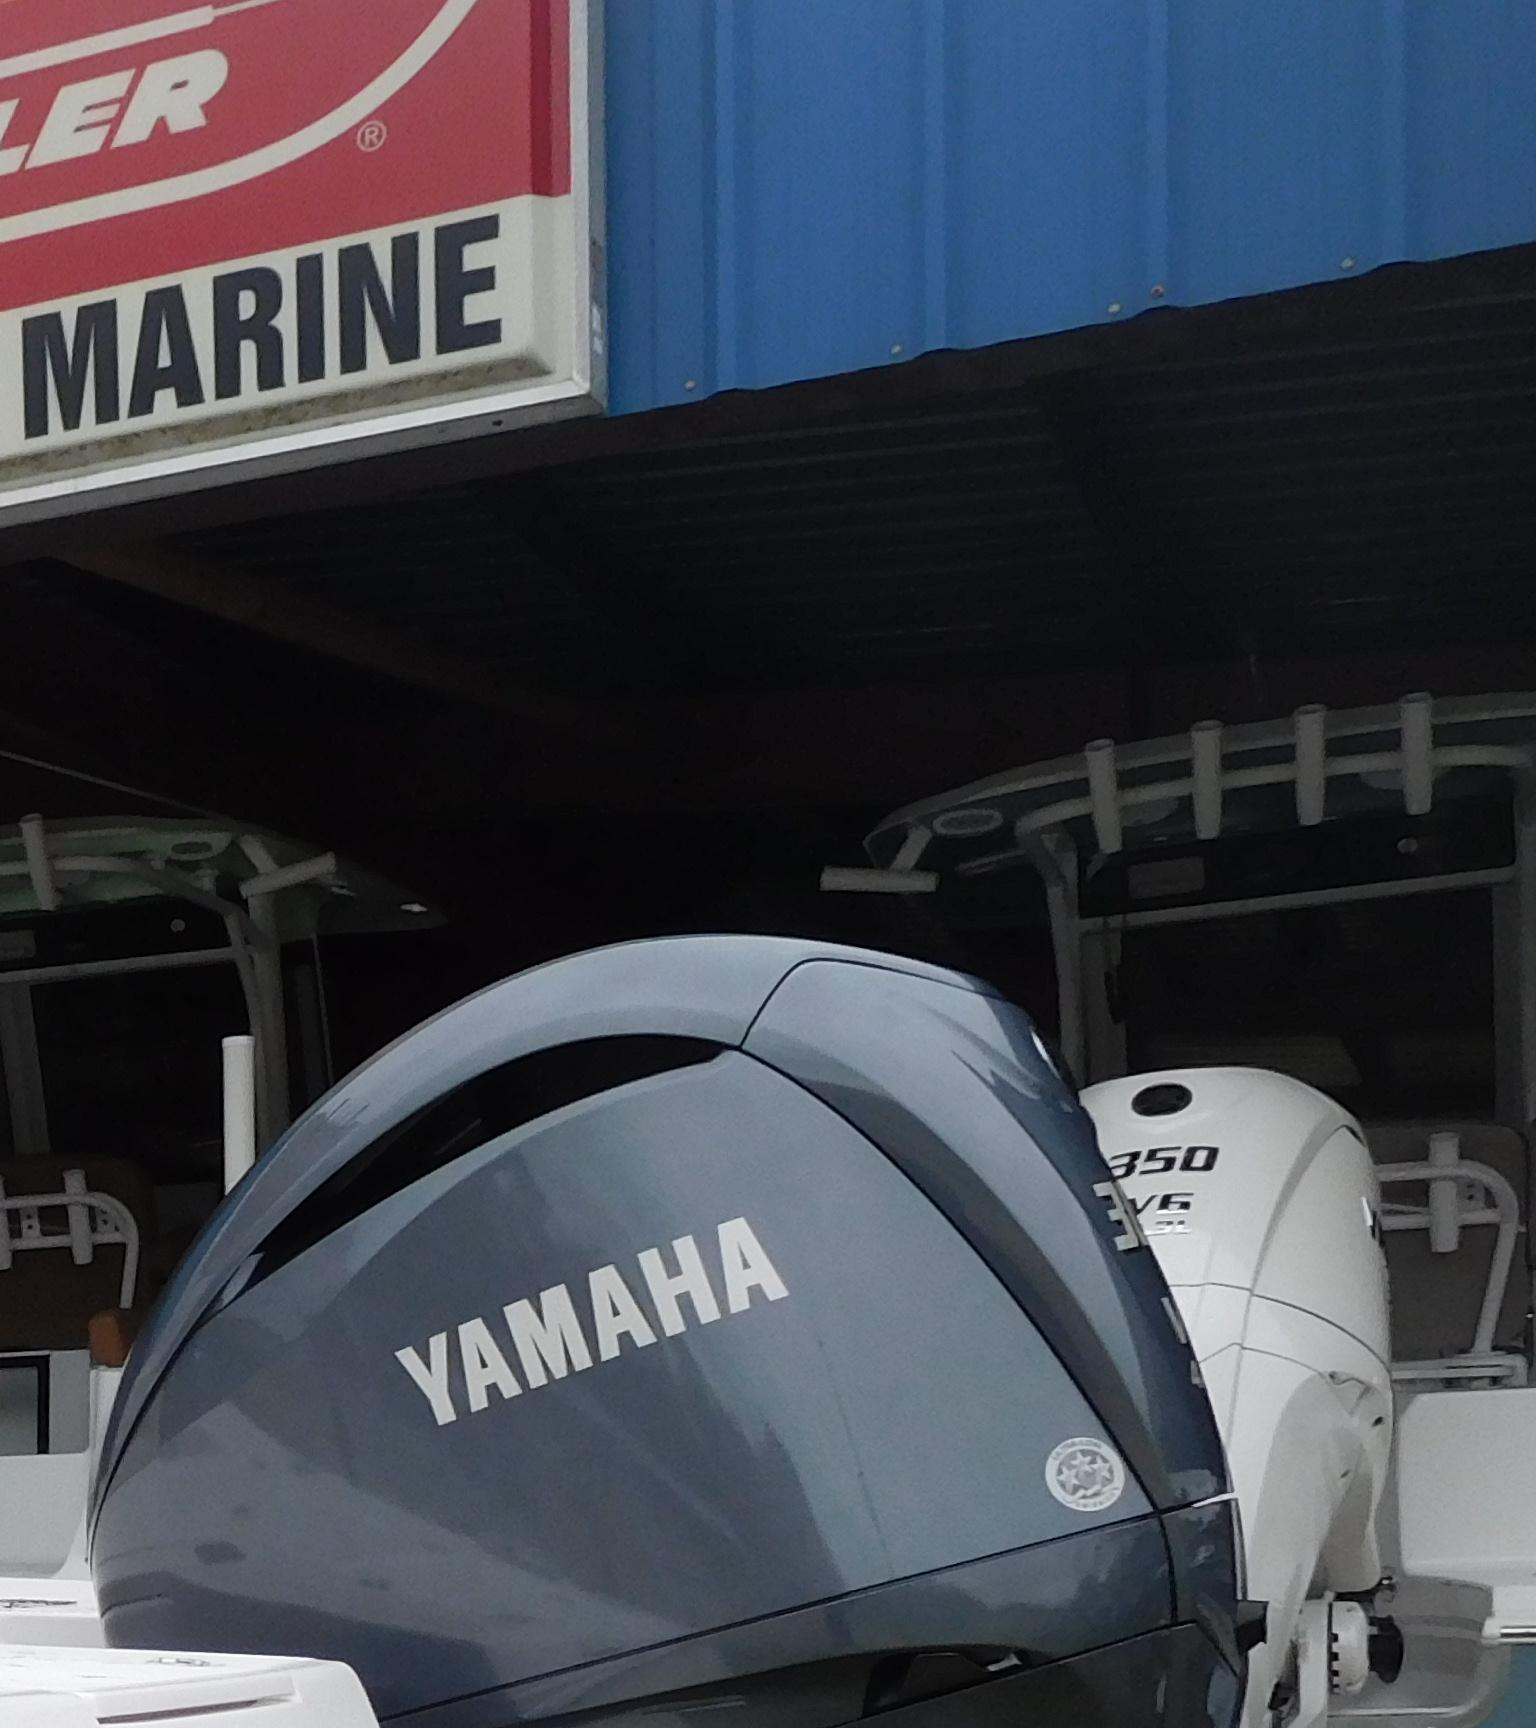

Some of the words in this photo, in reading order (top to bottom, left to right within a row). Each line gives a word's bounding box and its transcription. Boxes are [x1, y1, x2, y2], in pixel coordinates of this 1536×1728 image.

[21, 214, 504, 439] MARINE
[1110, 1145, 1220, 1181] 350
[395, 1216, 790, 1427] YAMAHA
